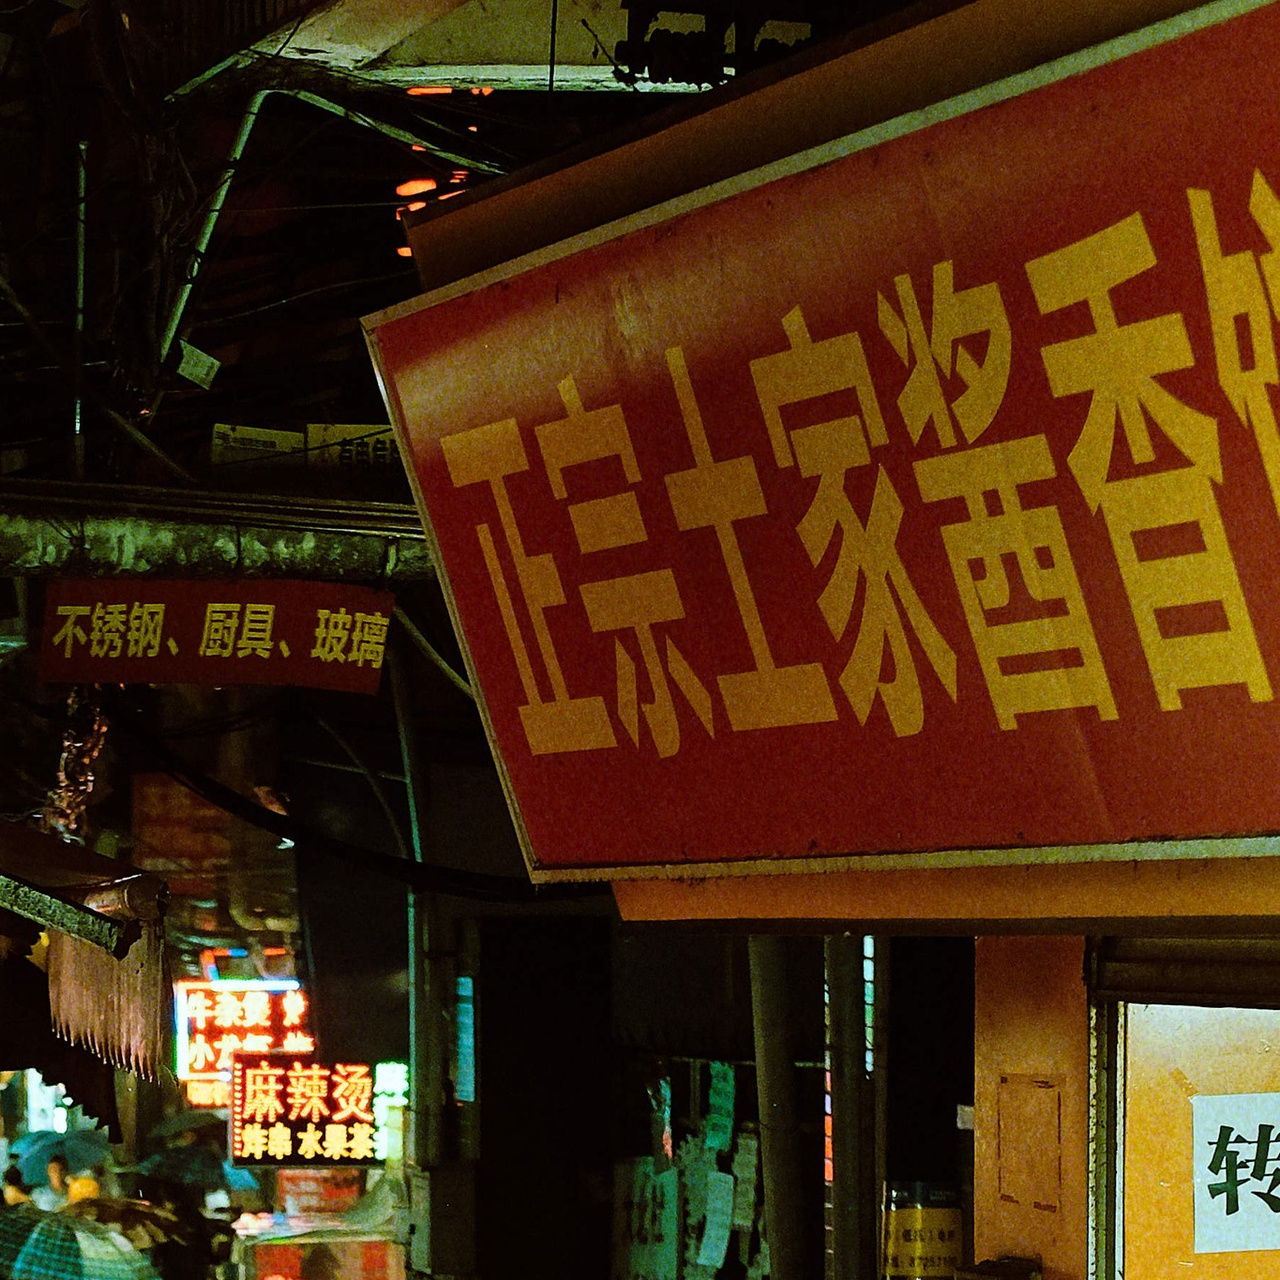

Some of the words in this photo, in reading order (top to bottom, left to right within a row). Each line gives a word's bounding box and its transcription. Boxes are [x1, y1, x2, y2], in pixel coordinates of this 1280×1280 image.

[242, 1060, 375, 1122] 麻辣烫
[241, 1122, 293, 1160] 炸串
